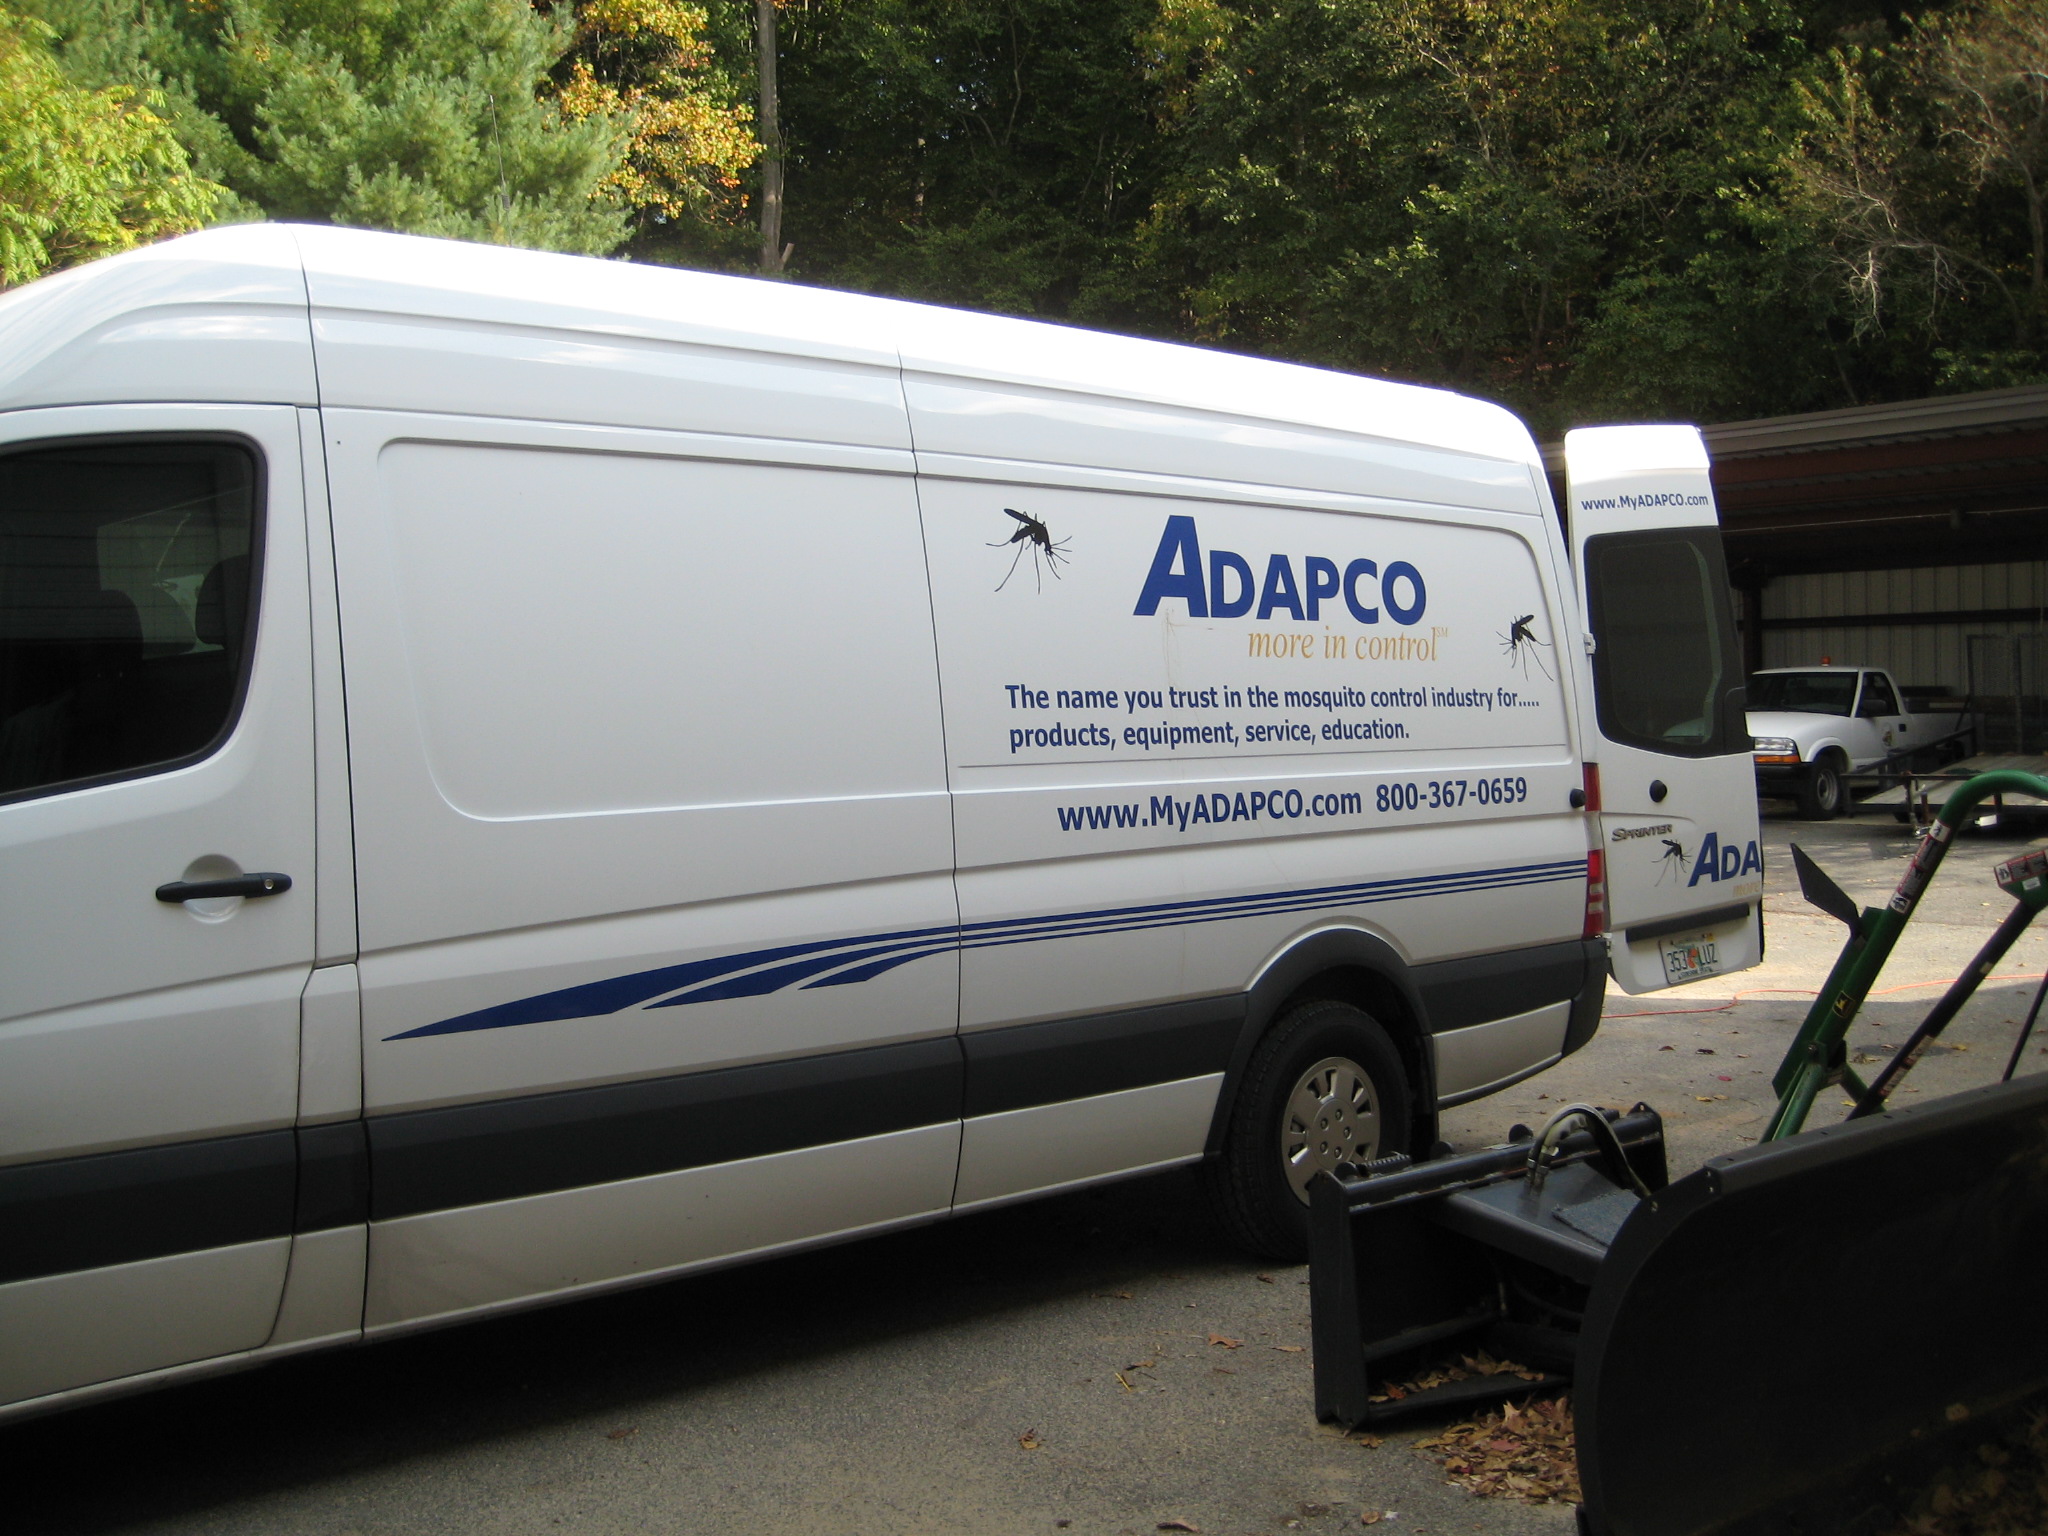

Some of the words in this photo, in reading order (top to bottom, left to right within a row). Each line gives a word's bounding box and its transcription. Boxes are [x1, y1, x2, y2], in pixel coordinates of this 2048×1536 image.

[1581, 493, 1709, 511] www.MyADAPCO.com
[1132, 515, 1427, 626] ADAPCO
[1248, 632, 1315, 659] more
[1323, 625, 1347, 660] in
[1354, 626, 1437, 662] control
[1005, 684, 1050, 709] The
[1057, 689, 1119, 709] name
[1124, 689, 1164, 714] you
[1169, 686, 1219, 708] trust
[1223, 685, 1243, 708] in
[1247, 685, 1279, 708] the
[1284, 686, 1365, 712] mosquito
[1370, 687, 1427, 708] control
[1431, 687, 1493, 711] industry
[1009, 722, 1117, 753] products,
[1123, 721, 1240, 750] equipment,
[1246, 719, 1317, 745] service,
[1321, 718, 1410, 740] education.
[1057, 788, 1362, 832] www.MyADAPCO.com
[1376, 777, 1528, 812] 800-367-0659
[1611, 824, 1672, 841] SPRINTER
